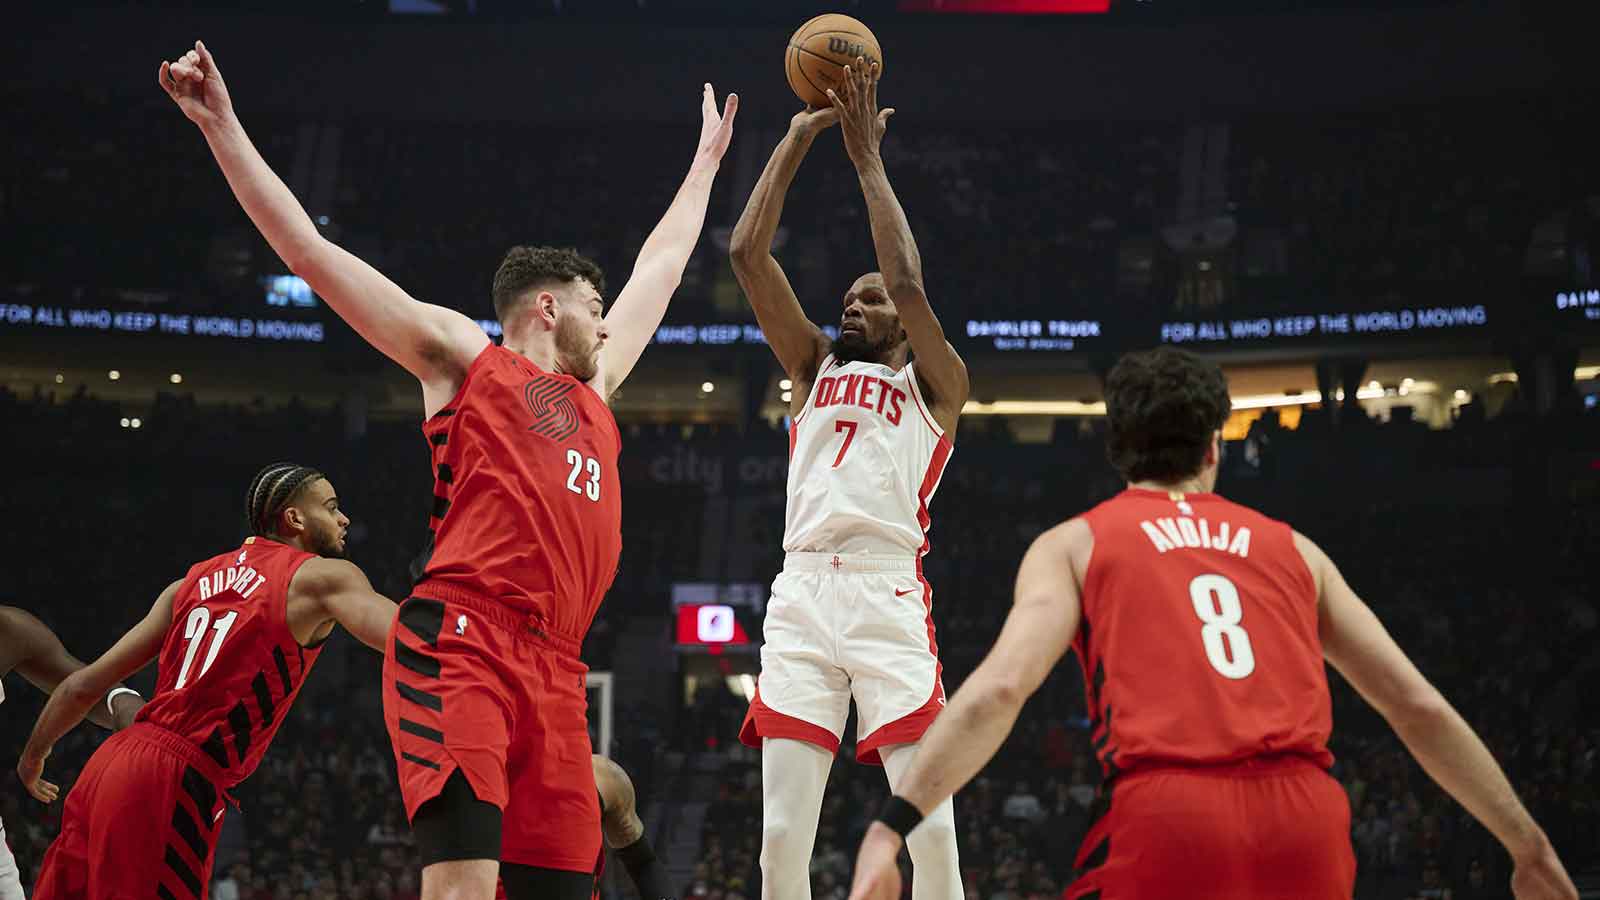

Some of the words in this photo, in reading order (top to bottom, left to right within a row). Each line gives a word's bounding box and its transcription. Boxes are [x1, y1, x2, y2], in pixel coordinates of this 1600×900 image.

[35, 306, 65, 327] ALL
[69, 309, 112, 330] WHO
[114, 311, 156, 332] KEEP
[158, 314, 190, 335] THE
[193, 316, 254, 339] WORLD
[256, 319, 325, 342] MOVING
[966, 320, 1042, 337] DAIMLER
[1048, 320, 1101, 337] TRUCK
[1160, 323, 1195, 343] FOR
[1198, 321, 1228, 341] ALL
[1230, 318, 1272, 340] WHO
[1273, 315, 1316, 337] KEEP
[1318, 313, 1350, 334] THE
[1353, 309, 1415, 333] WORLD
[1416, 304, 1487, 328] MOVING
[814, 373, 906, 427] OCKETS
[831, 420, 858, 468] 7
[566, 449, 601, 502] 23
[1140, 517, 1251, 558] AVDIJA
[175, 606, 238, 690] 21
[1189, 574, 1256, 680] 8
